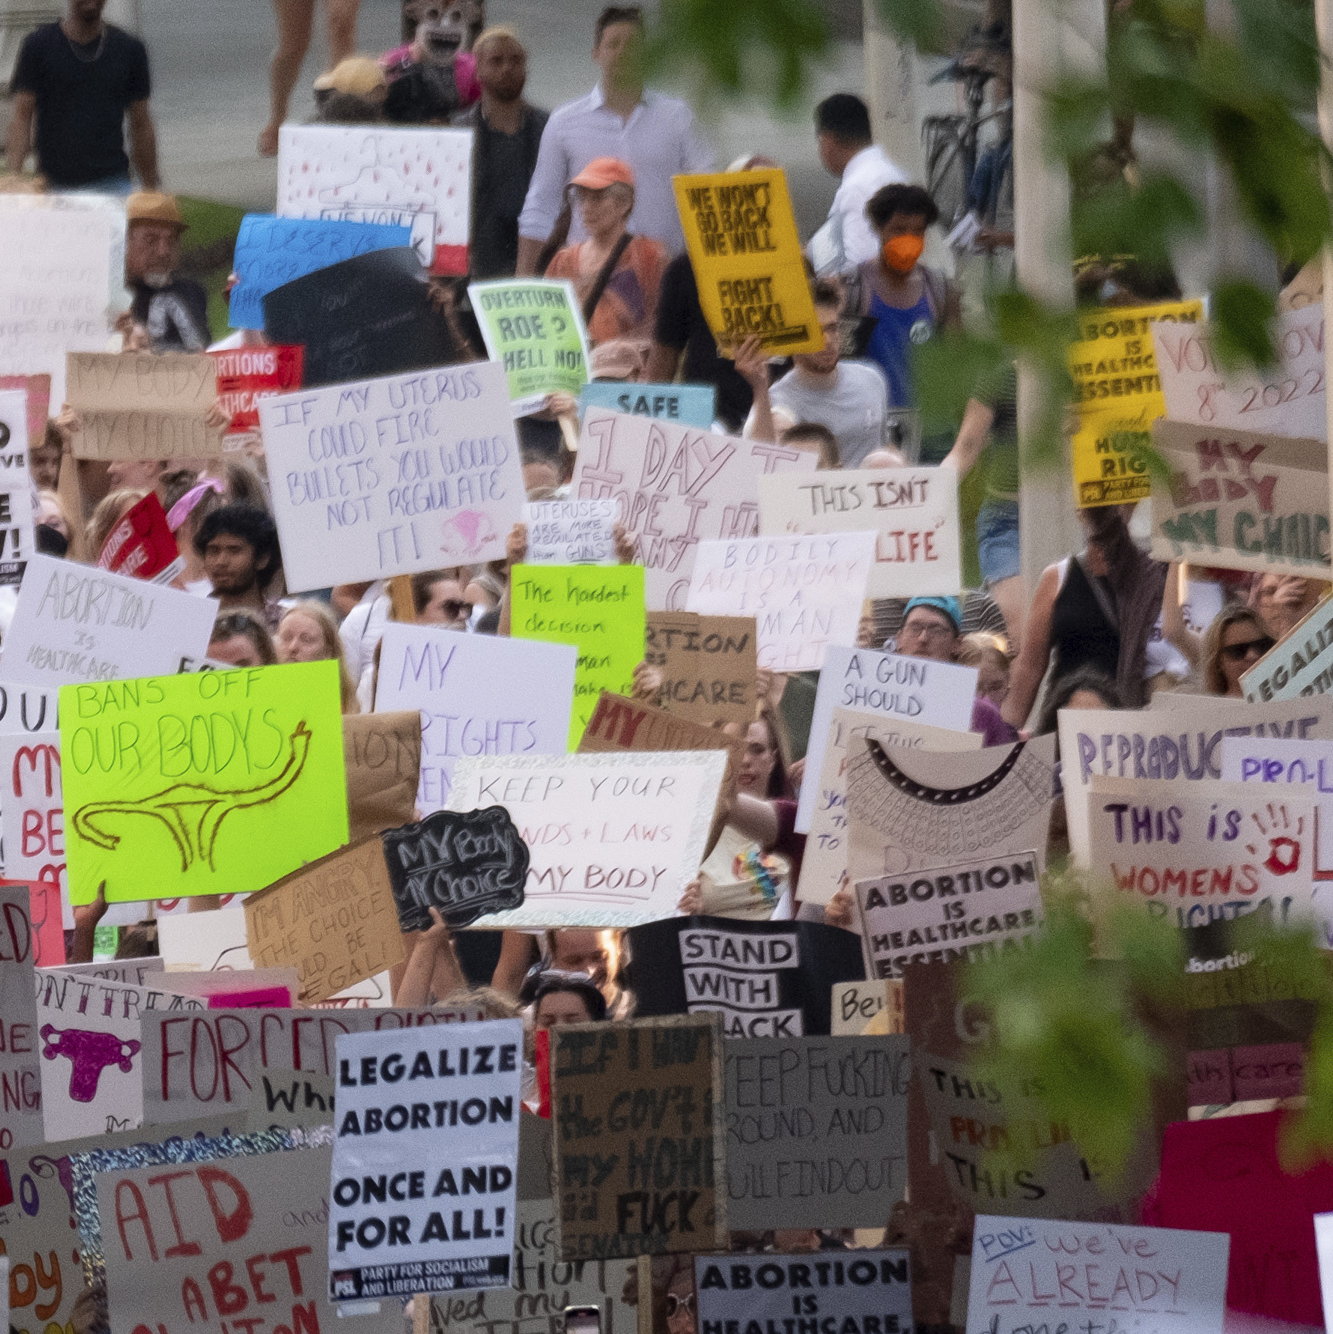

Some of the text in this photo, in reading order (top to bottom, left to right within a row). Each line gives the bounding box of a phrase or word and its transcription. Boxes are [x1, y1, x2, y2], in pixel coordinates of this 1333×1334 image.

[481, 290, 566, 310] OVERTURN
[498, 316, 547, 341] ROE
[390, 373, 481, 405] UTERUS
[287, 457, 379, 505] BULLETS
[389, 470, 505, 516] REGULATE
[805, 485, 863, 514] THIS
[567, 580, 630, 604] hardest
[398, 644, 455, 690] MY
[875, 658, 927, 687] GUN
[75, 668, 263, 718] BANS OFF
[843, 687, 924, 717] SHOULD
[70, 708, 283, 777] OUR BODYS
[478, 777, 677, 802] KEEP YOUR
[1104, 806, 1183, 843] THIS
[865, 861, 1036, 911] ABORTION
[1110, 864, 1260, 897] WOMENS
[943, 901, 966, 920] IS
[683, 934, 795, 966] STAND
[689, 972, 773, 1002] WITH
[340, 1045, 517, 1087] LEGALIZE
[339, 1097, 513, 1138] ABORTION
[334, 1166, 513, 1207] ONCE AND
[115, 1166, 252, 1262] AID
[336, 1207, 506, 1252] FOR ALL!
[181, 1247, 312, 1323] ABET
[361, 1258, 489, 1281] PARTY FOR SOCIALISM
[699, 1260, 908, 1291] ABORTION
[987, 1261, 1186, 1301] ALREADY
[362, 1282, 385, 1296] AND
[387, 1276, 455, 1293] LIBERATION
[793, 1295, 818, 1315] IS
